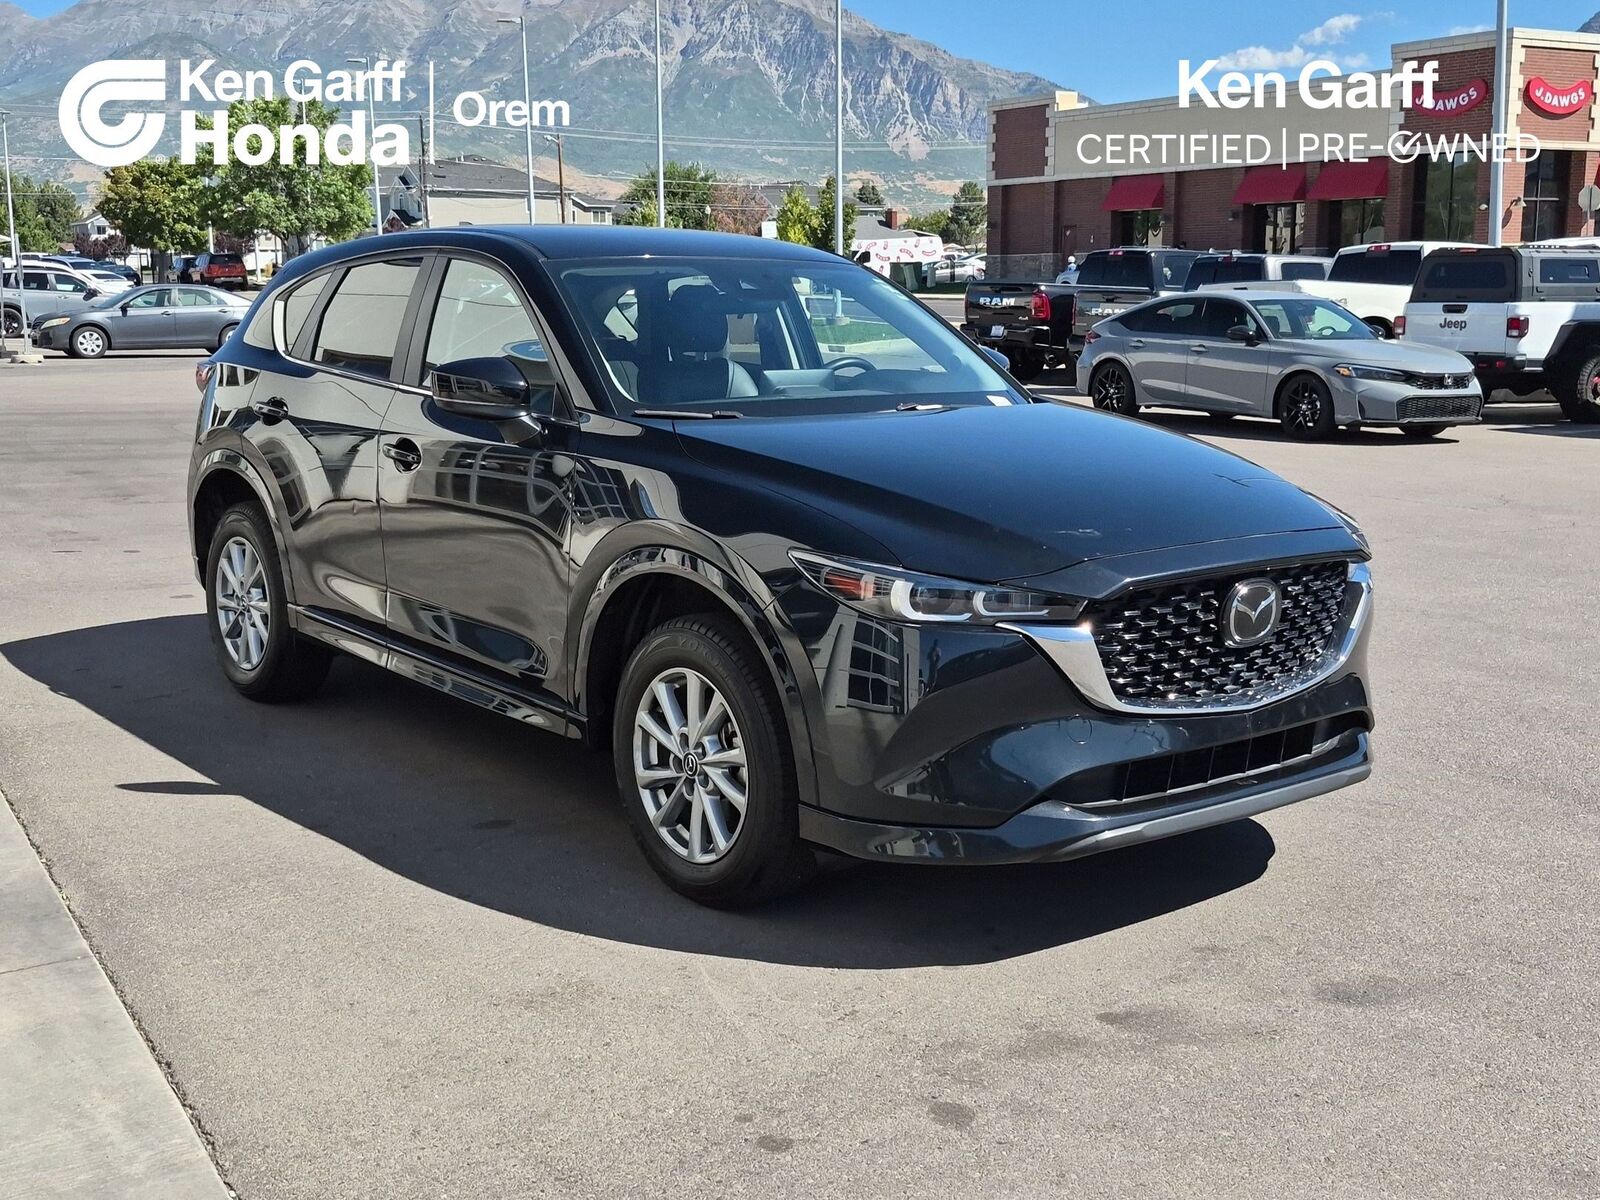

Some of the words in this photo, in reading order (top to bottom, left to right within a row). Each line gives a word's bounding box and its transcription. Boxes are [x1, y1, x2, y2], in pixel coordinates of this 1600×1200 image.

[1535, 87, 1585, 107] J.DAWGS
[979, 297, 1016, 306] RAM
[1439, 317, 1467, 331] Jeep
